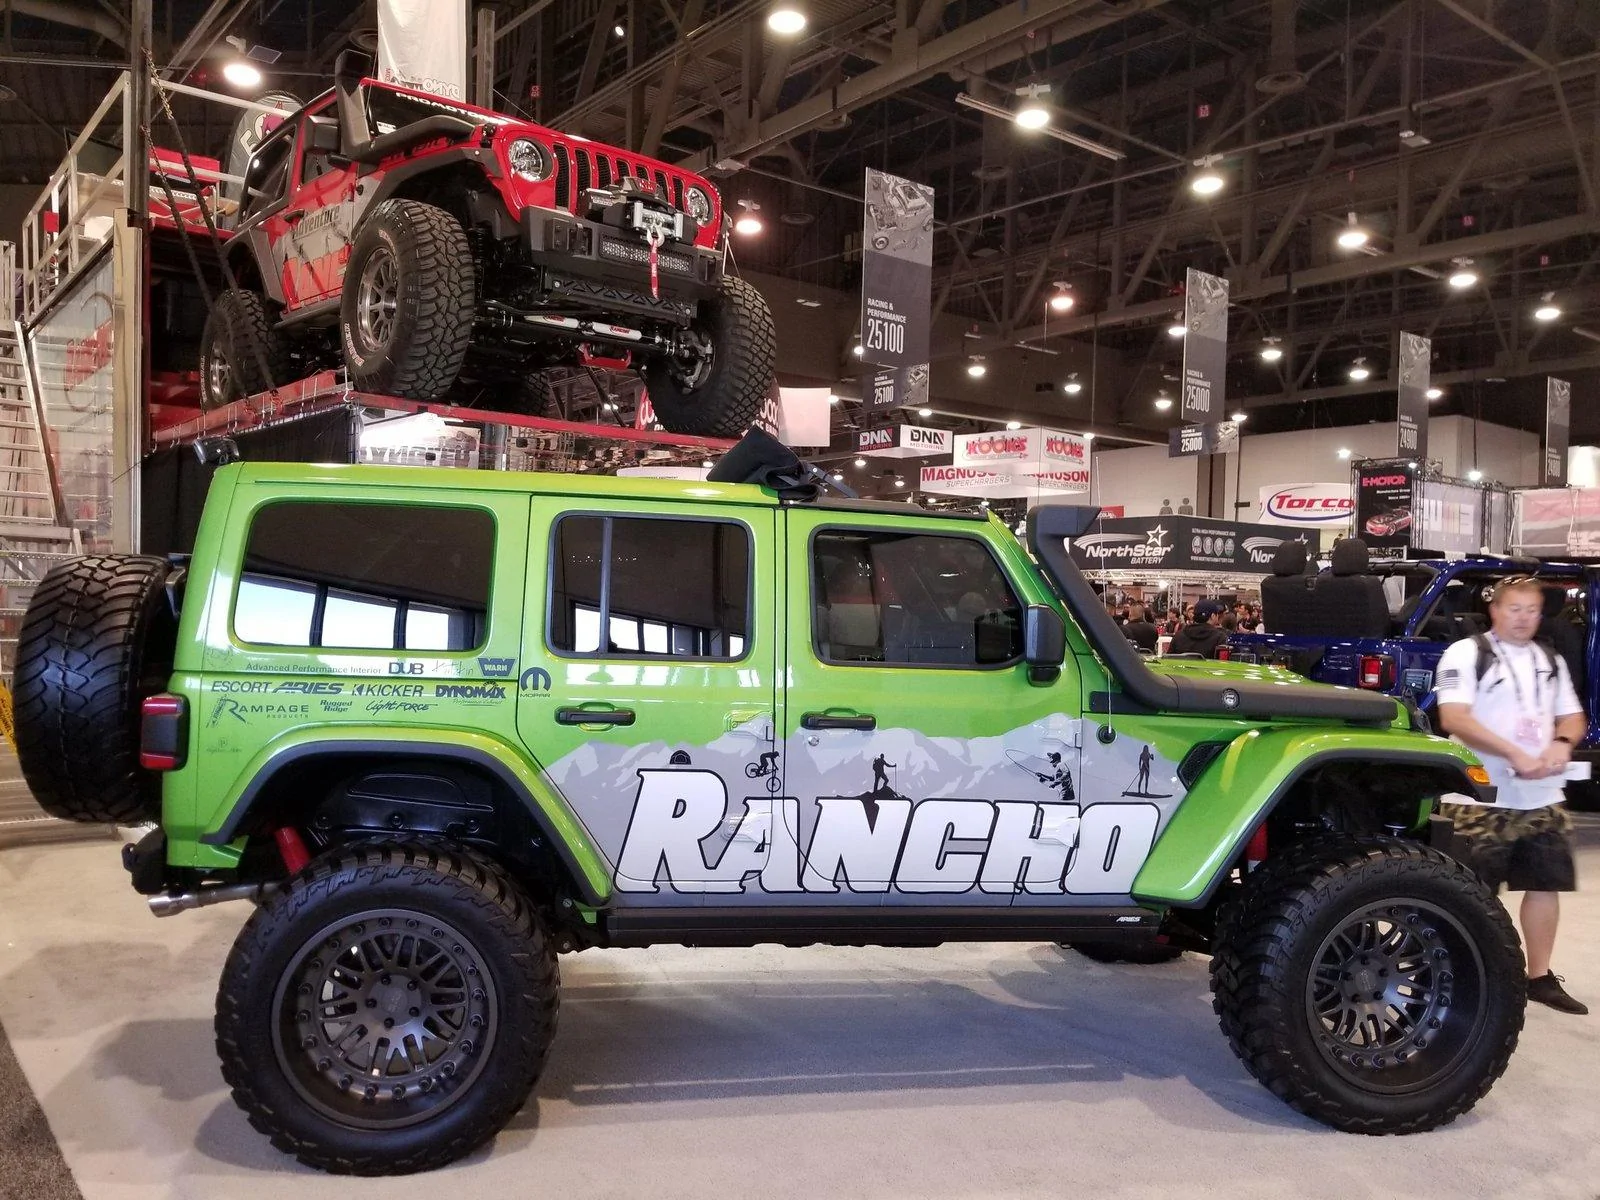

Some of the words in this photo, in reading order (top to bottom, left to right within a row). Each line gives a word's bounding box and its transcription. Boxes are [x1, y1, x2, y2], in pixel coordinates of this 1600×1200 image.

[867, 298, 888, 310] RACING
[889, 302, 894, 311] &
[867, 308, 907, 323] PERFORMANCE
[867, 318, 904, 354] 25100
[874, 385, 894, 405] 25100
[1186, 385, 1210, 412] 25000
[859, 428, 893, 445] DNA
[910, 429, 945, 444] DNA
[859, 442, 893, 451] MOTORING
[909, 442, 945, 450] MOTORING
[1181, 437, 1203, 452] 25000
[946, 476, 1010, 488] SUPERCHARGERS
[1037, 480, 1089, 490] SUPERCHARGERS
[1362, 475, 1406, 487] E-MOTOR
[1275, 494, 1355, 510] Torco
[1086, 544, 1171, 558] NorthStar
[1130, 556, 1164, 565] BATTERY
[246, 663, 290, 672] Advanced
[292, 664, 348, 673] Performance
[350, 666, 381, 674] Interior
[388, 662, 424, 675] DUB
[483, 663, 508, 672] WARN
[211, 680, 273, 693] ESCORT
[272, 681, 345, 695] ARIES
[365, 684, 424, 698] KICKER
[435, 684, 507, 699] DYNOMAX
[319, 699, 353, 707] Rugged
[323, 705, 349, 713] Ridge
[613, 768, 1162, 896] RANCHO
